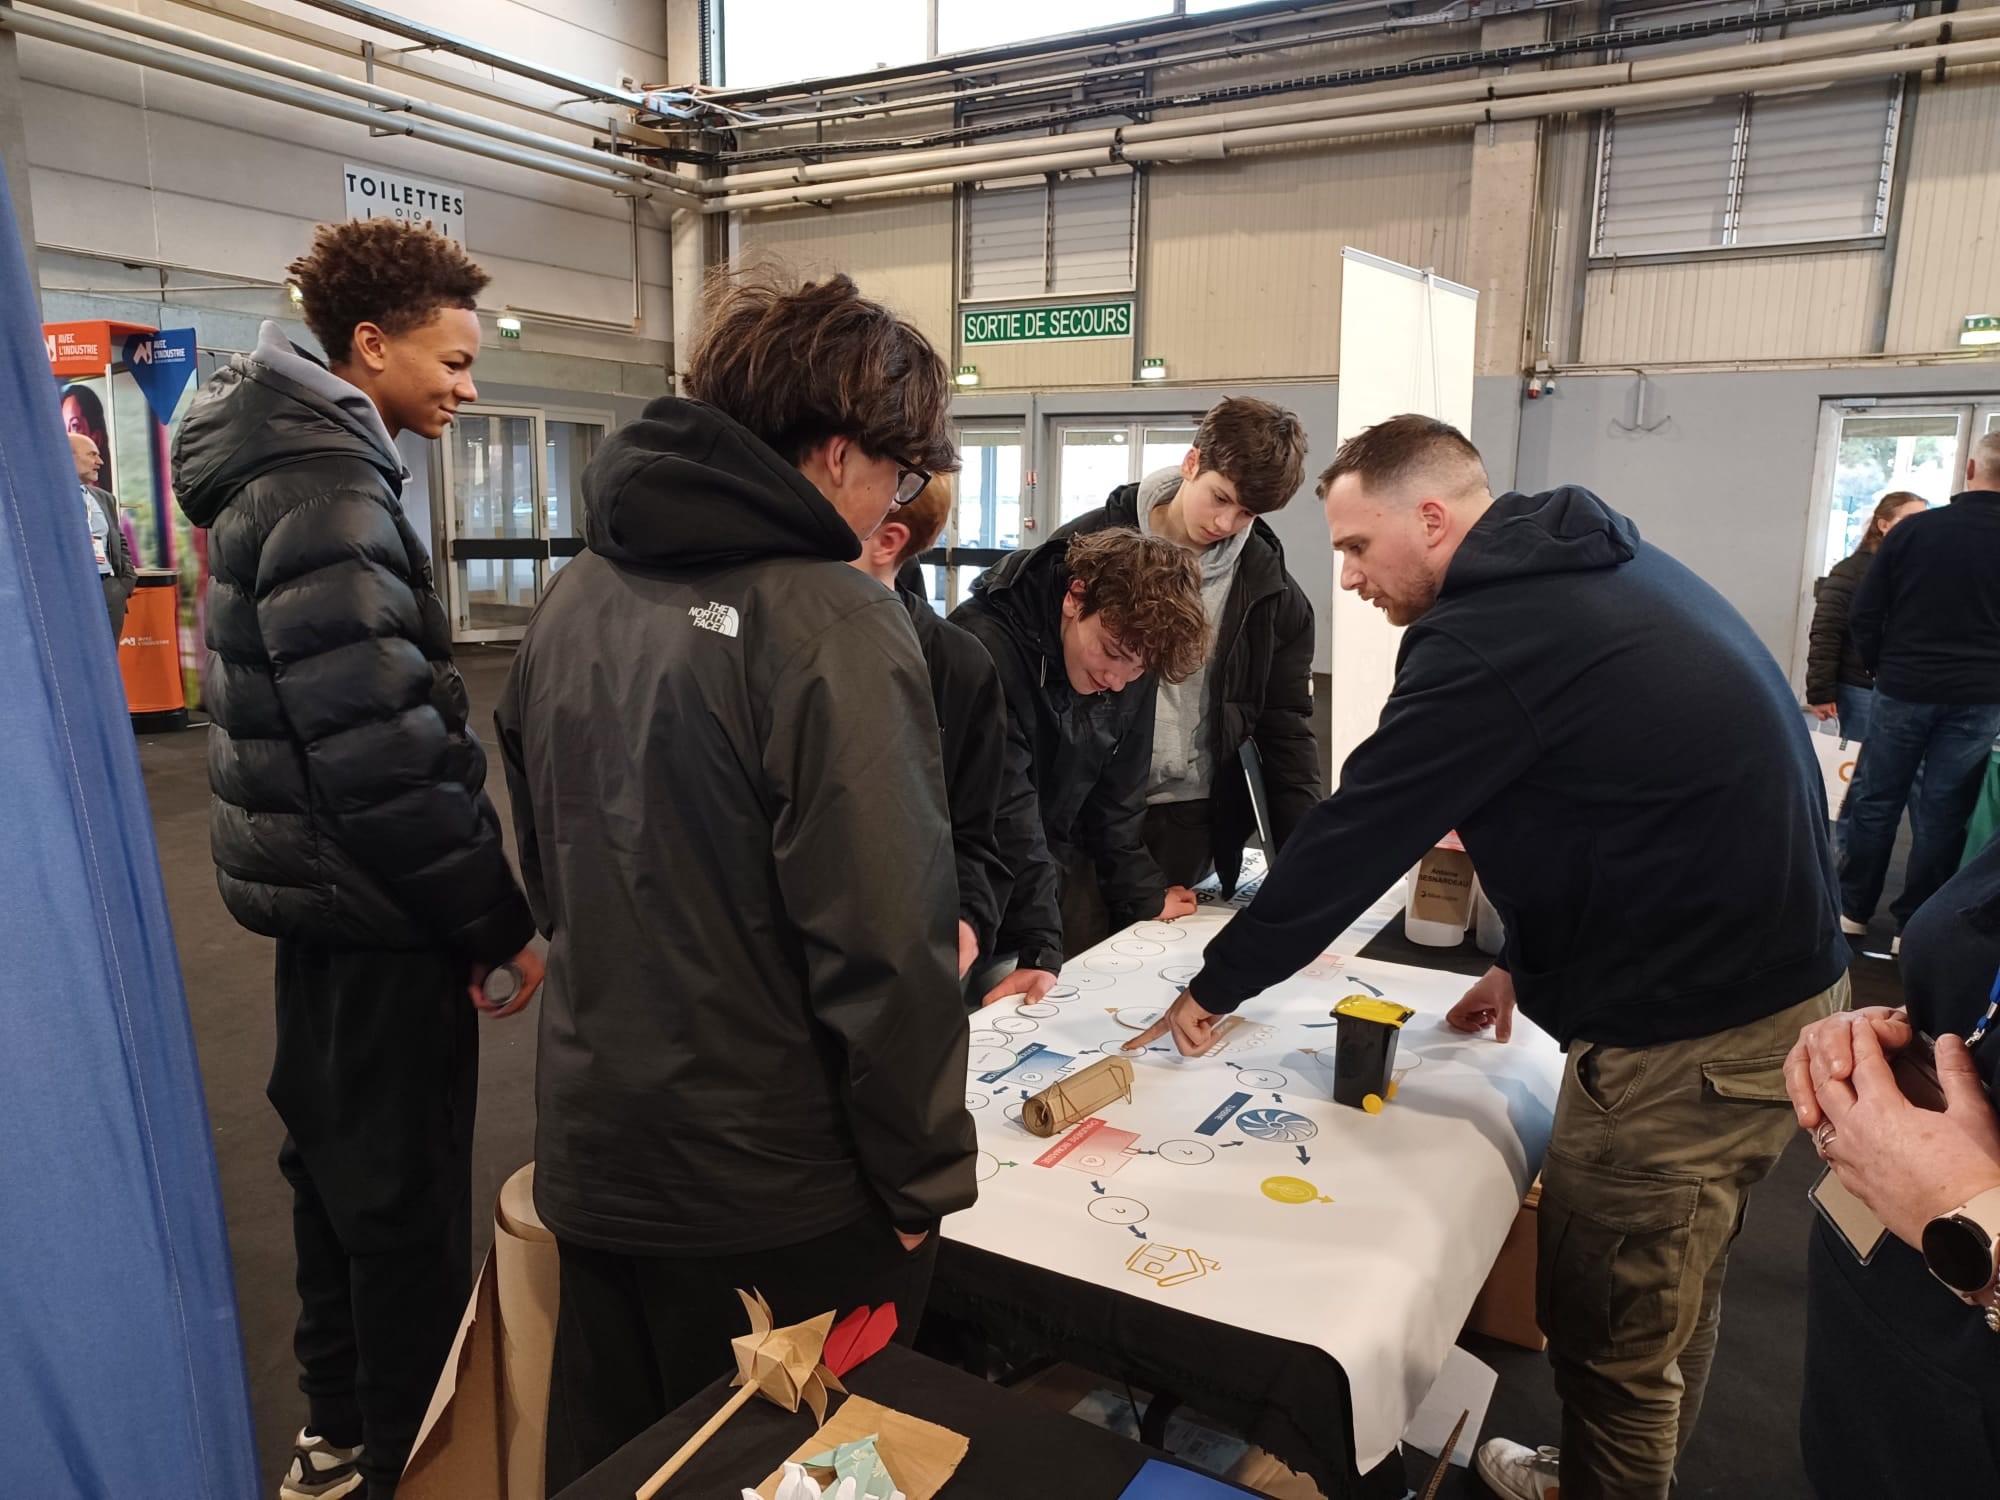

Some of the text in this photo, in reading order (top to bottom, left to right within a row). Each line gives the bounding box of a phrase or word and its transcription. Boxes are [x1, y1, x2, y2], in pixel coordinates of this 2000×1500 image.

[346, 173, 463, 215] TOILETTES
[967, 306, 1128, 340] SORTIE DE SECOURS
[58, 333, 75, 344] AVEC
[58, 344, 98, 356] L'INDUSTRIE
[688, 606, 726, 624] NORTH
[708, 601, 729, 615] THE
[692, 617, 721, 632] FACE
